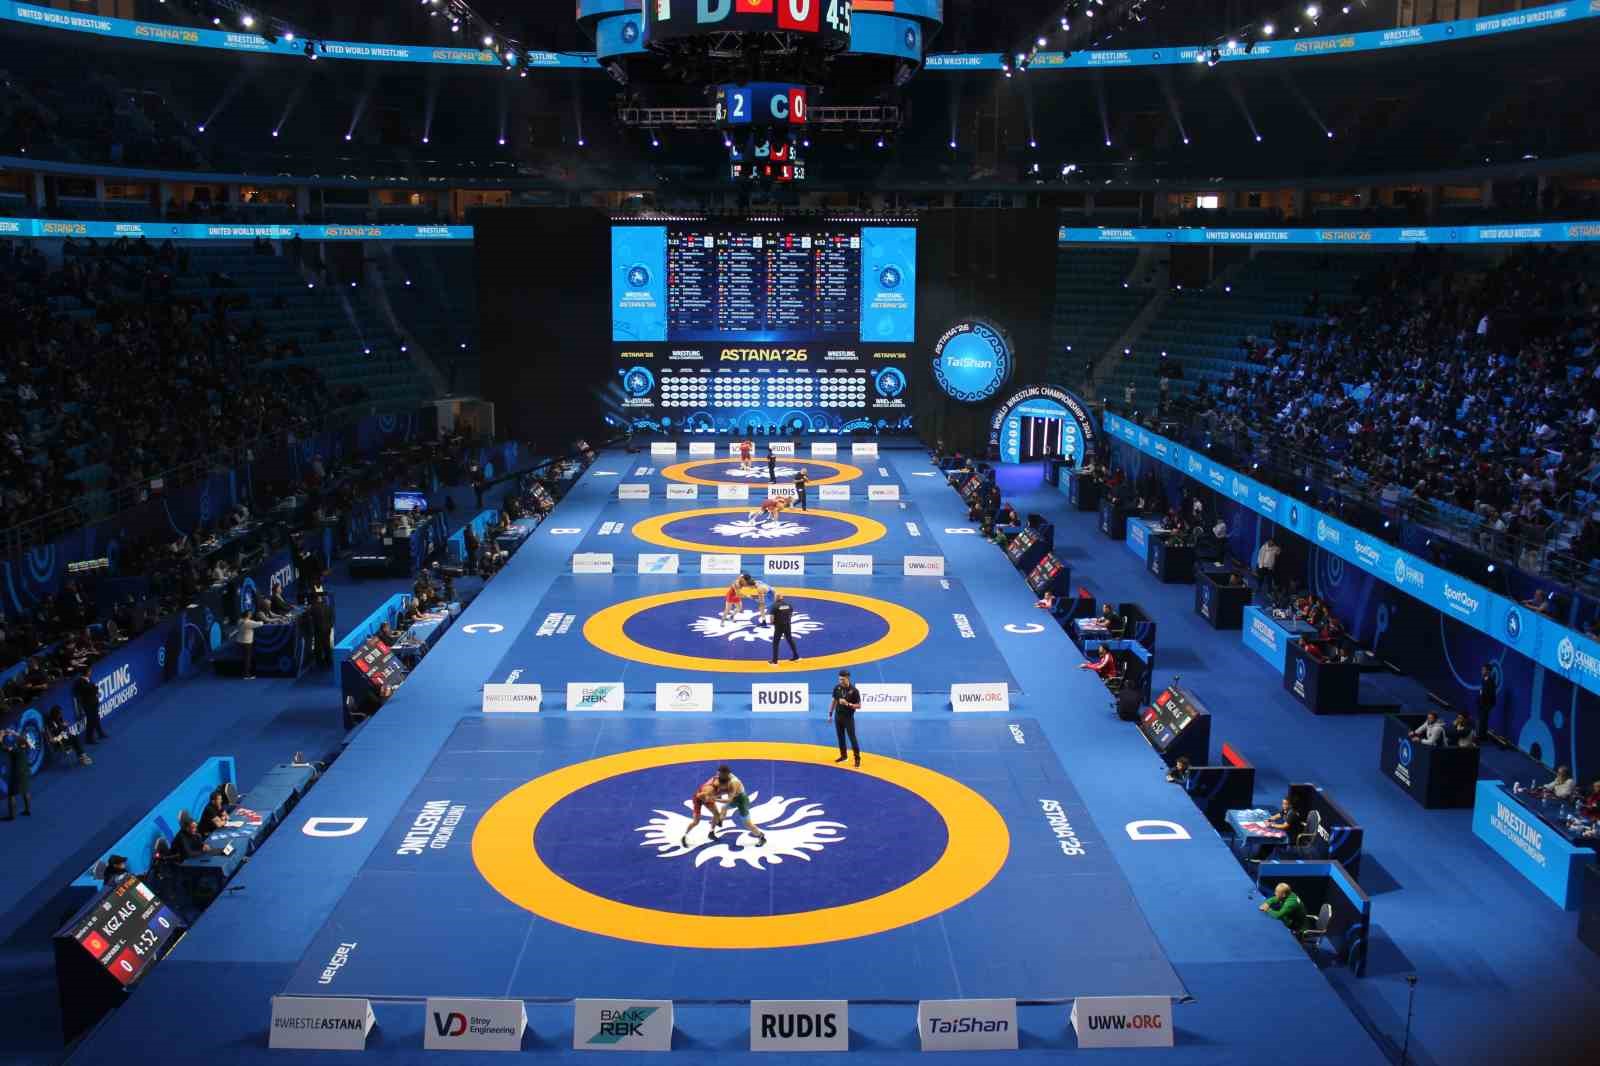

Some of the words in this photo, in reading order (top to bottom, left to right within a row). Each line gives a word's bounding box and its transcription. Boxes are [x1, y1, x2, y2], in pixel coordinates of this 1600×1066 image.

[18, 7, 44, 20] UNITED
[44, 12, 71, 25] WORLD
[70, 16, 112, 31] WRESTLING
[1475, 19, 1501, 32] UNITED
[1500, 14, 1526, 27] WORLD
[1525, 7, 1568, 22] WRESTLING
[345, 46, 371, 55] WORLD
[371, 47, 410, 59] WRESTLING
[944, 56, 982, 65] WRESTLING
[733, 94, 745, 117] 2
[770, 94, 789, 119] C
[794, 95, 804, 118] 0
[1206, 231, 1230, 240] UNITED
[1230, 231, 1254, 240] WORLD
[1254, 231, 1288, 240] WRESTLING
[720, 348, 808, 361] ASTANA'26
[947, 356, 992, 369] TaiShan
[771, 488, 796, 496] RUDIS
[768, 560, 800, 571] RUDIS
[462, 623, 504, 634] C
[1003, 623, 1045, 634] C
[758, 690, 802, 705] RUDIS
[862, 692, 907, 703] TaiShan
[958, 692, 1003, 704] UWW.ORG
[442, 805, 466, 826] UNITED
[302, 817, 368, 837] D
[396, 800, 451, 855] WRESTLING
[1039, 799, 1086, 856] ASTANA'26
[1125, 819, 1192, 841] D
[1497, 801, 1542, 850] WRESTLING
[430, 826, 455, 849] WORLD
[102, 915, 123, 938] KGZ
[119, 900, 137, 921] ALG
[157, 916, 170, 929] 0
[132, 928, 158, 956] 4:52
[120, 959, 133, 973] 0
[317, 941, 357, 984] TaiShan
[470, 1016, 492, 1027] Stroy
[600, 1009, 643, 1021] BANK
[1087, 1015, 1162, 1031] UWW.ORG
[274, 1017, 363, 1031] #WRESTLEASTANA
[470, 1025, 516, 1035] Engineering
[600, 1021, 645, 1037] RBK
[761, 1013, 838, 1038] RUDIS
[928, 1017, 1009, 1034] TaiShan
